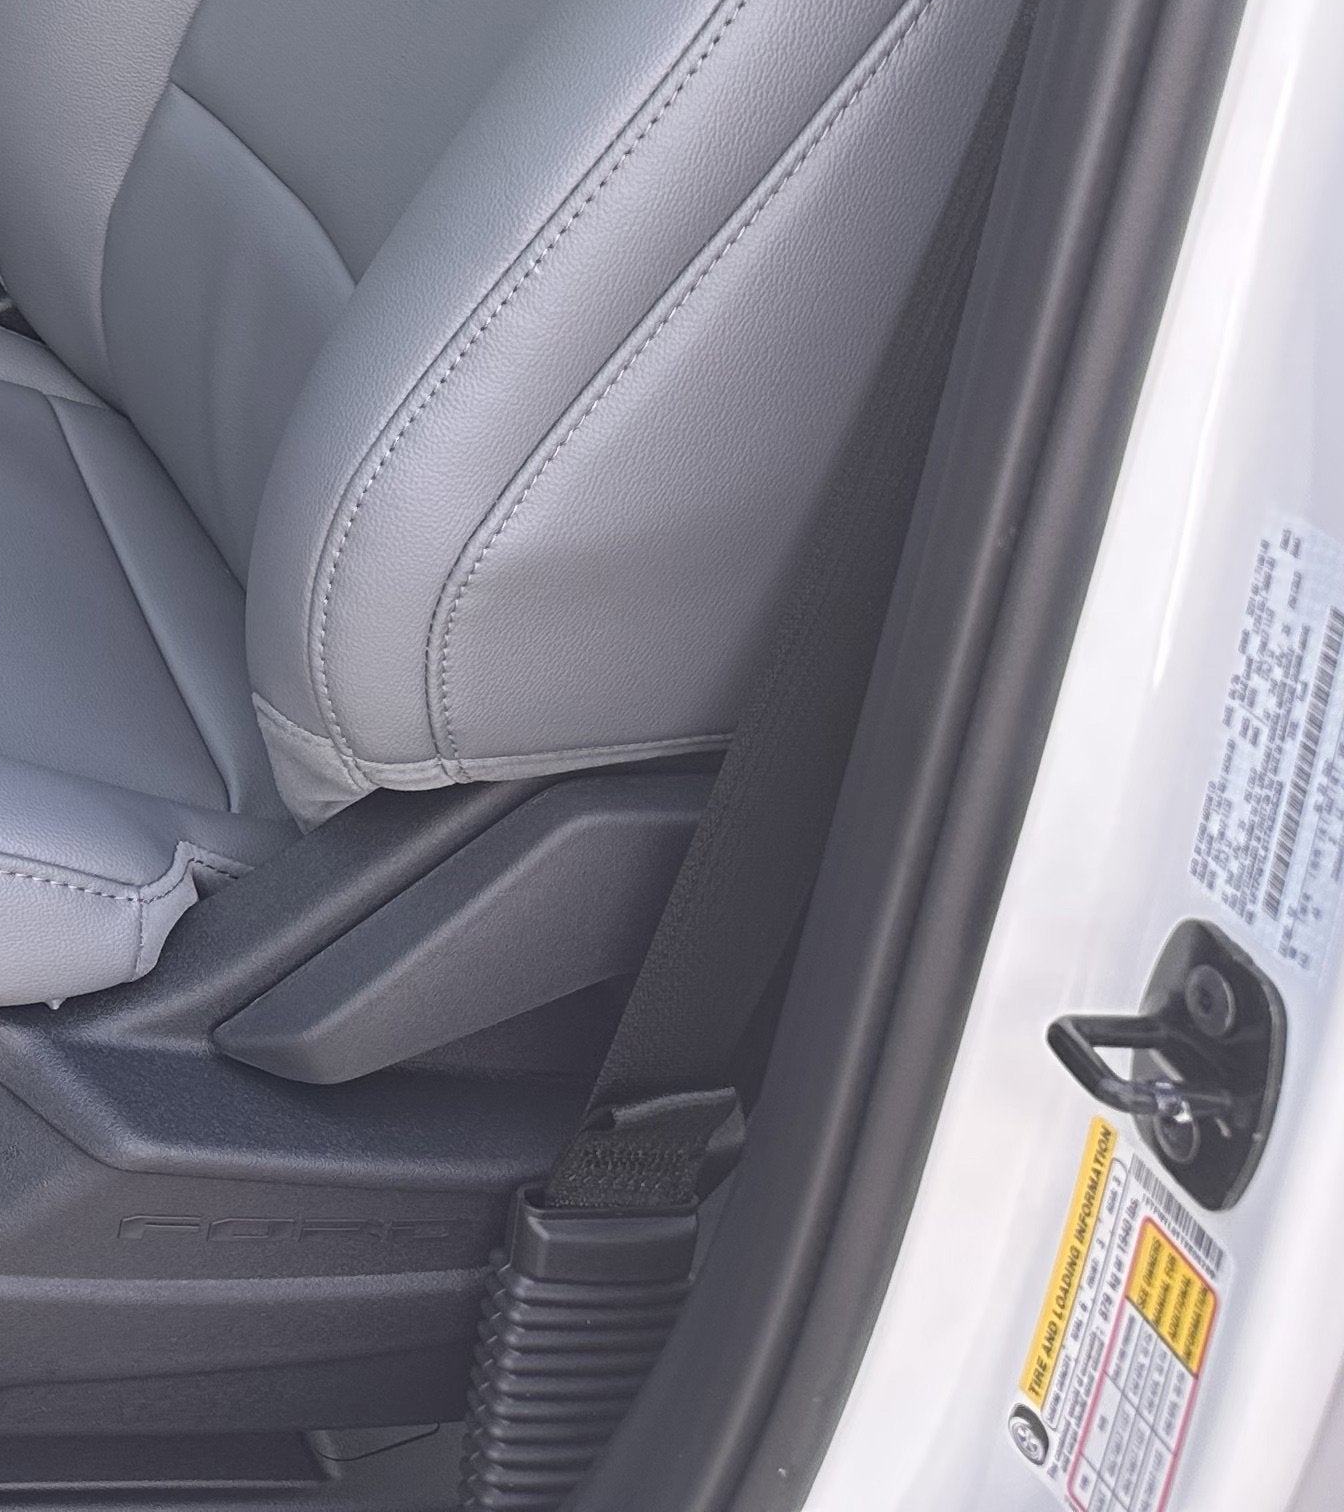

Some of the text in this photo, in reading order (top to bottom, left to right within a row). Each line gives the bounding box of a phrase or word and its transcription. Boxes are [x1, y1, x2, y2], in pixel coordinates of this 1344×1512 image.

[116, 1212, 474, 1242] FORD
[1027, 1357, 1048, 1397] TIRE
[1042, 1322, 1060, 1357] AND
[1053, 1244, 1081, 1319] LOADING
[1073, 1123, 1113, 1245] INFORMATION
